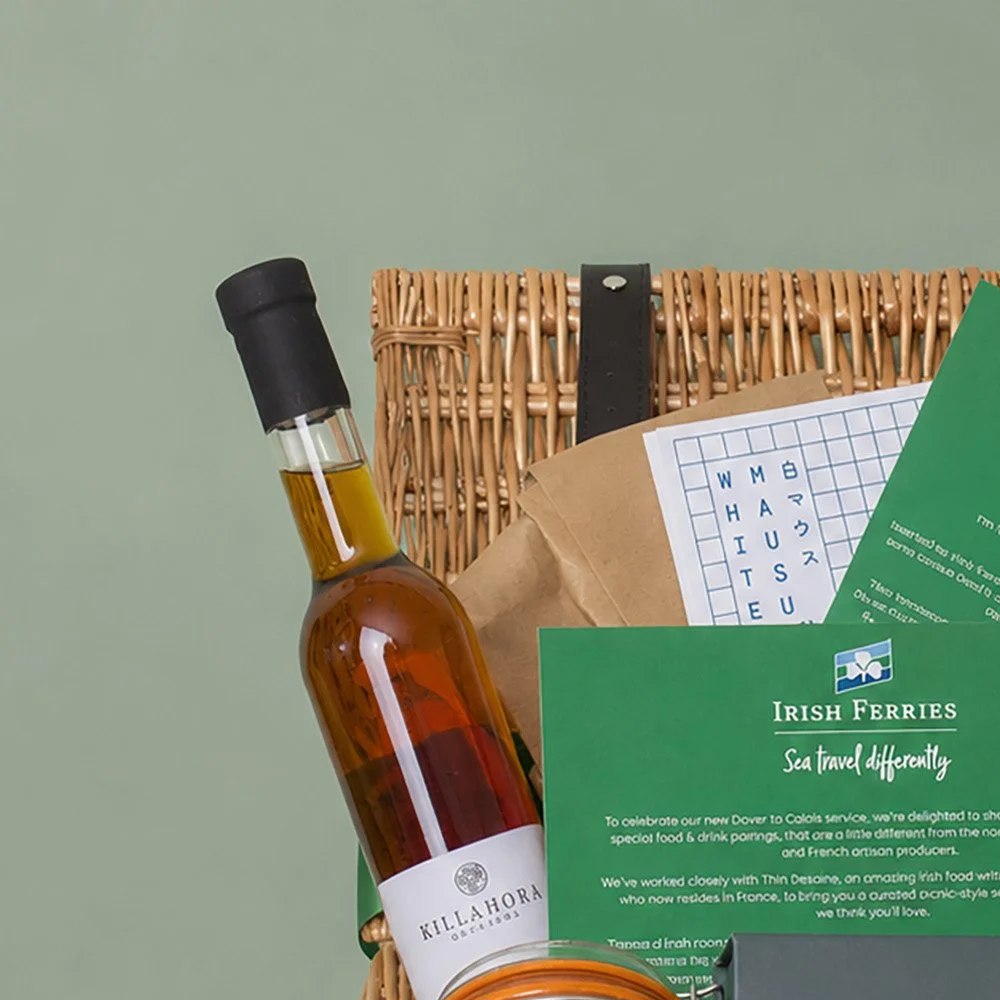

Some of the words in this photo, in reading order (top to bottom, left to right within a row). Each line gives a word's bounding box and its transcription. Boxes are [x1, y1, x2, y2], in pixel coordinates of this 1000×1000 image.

[783, 748, 812, 773] Sea
[816, 743, 862, 776] travel
[865, 743, 952, 782] differently
[605, 816, 619, 827] To
[681, 817, 701, 826] our
[704, 816, 729, 826] new
[732, 814, 767, 825] Dover
[770, 815, 783, 824] to
[968, 811, 980, 821] to
[656, 831, 684, 843] food
[697, 830, 729, 842] drink
[784, 830, 810, 841] that
[812, 831, 833, 840] are
[835, 831, 844, 840] a
[928, 828, 957, 838] from
[959, 828, 980, 837] the
[781, 847, 806, 858] and
[808, 846, 849, 857] French
[731, 874, 759, 885] with
[844, 874, 861, 884] an
[863, 872, 916, 885] amazing
[945, 870, 973, 881] food
[619, 893, 645, 905] who
[648, 895, 674, 904] now
[721, 891, 735, 903] in
[783, 891, 797, 902] to
[798, 891, 830, 904] bring
[831, 892, 855, 904] you
[419, 884, 543, 941] KILLAHORA
[815, 909, 834, 918] we
